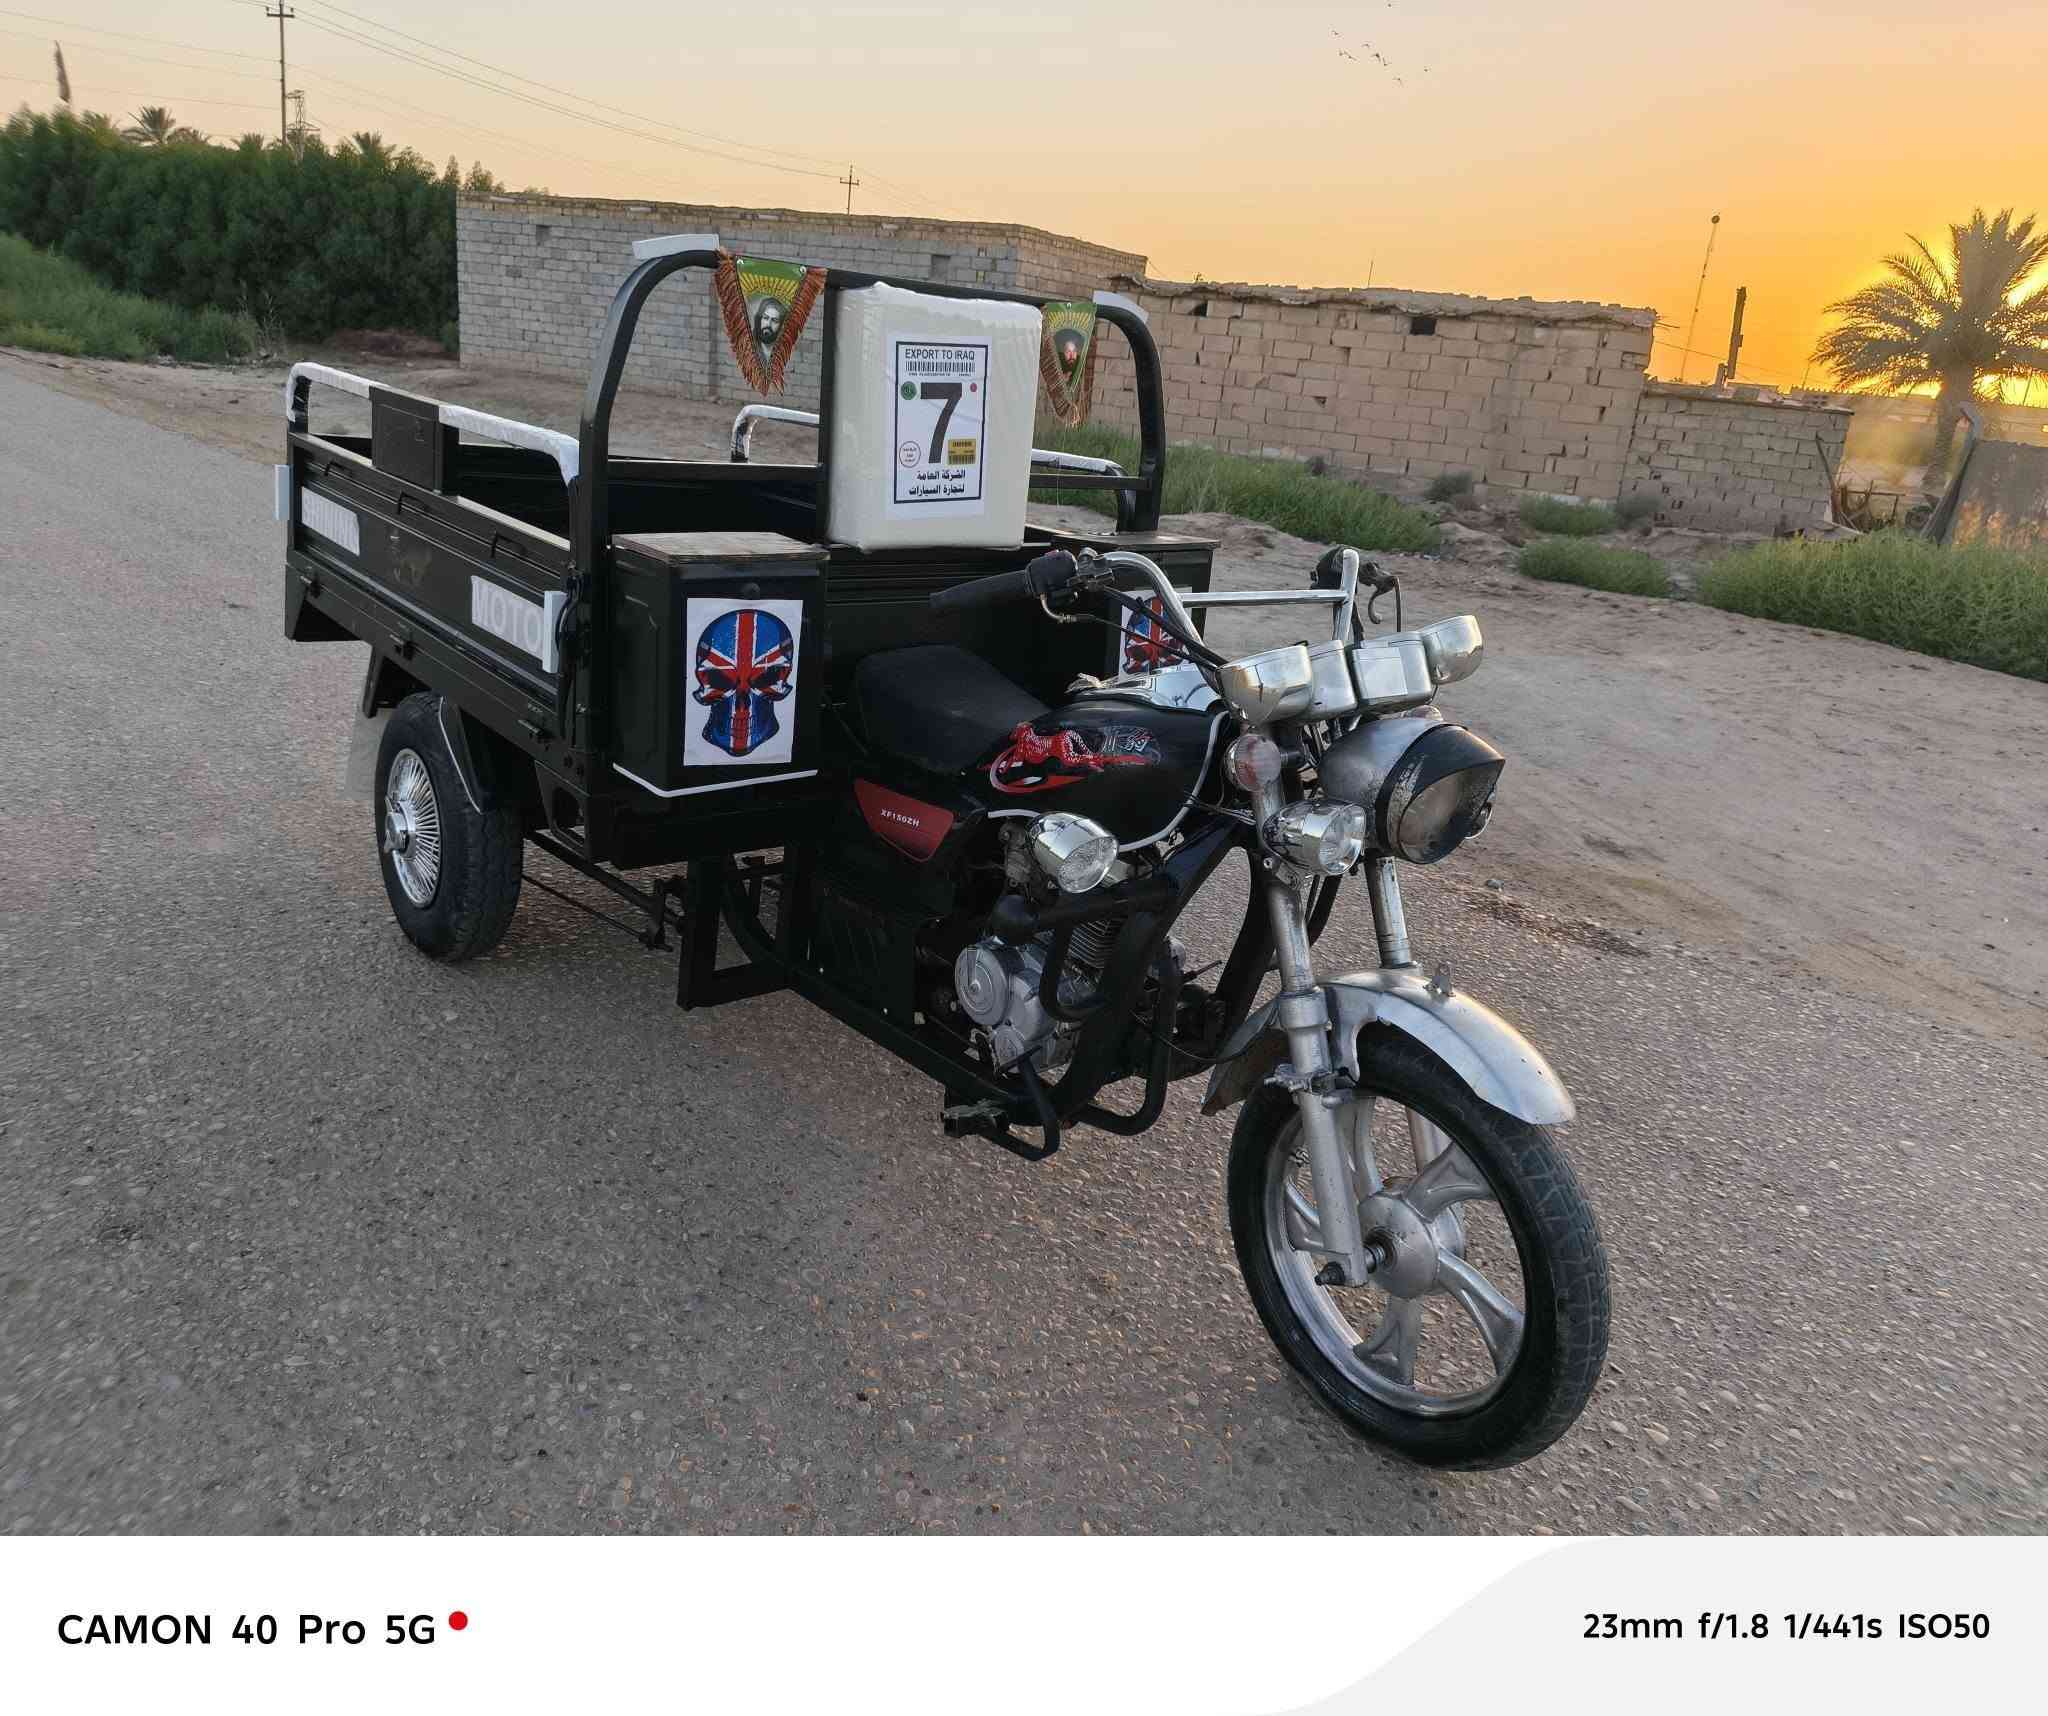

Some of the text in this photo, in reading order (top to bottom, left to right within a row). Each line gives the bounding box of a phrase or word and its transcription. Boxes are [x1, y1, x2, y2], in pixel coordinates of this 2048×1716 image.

[905, 348, 975, 361] EXPORT TO IRAQ
[920, 382, 963, 464] 7
[916, 469, 966, 481] الشركة العامة
[908, 484, 941, 497] السيارات
